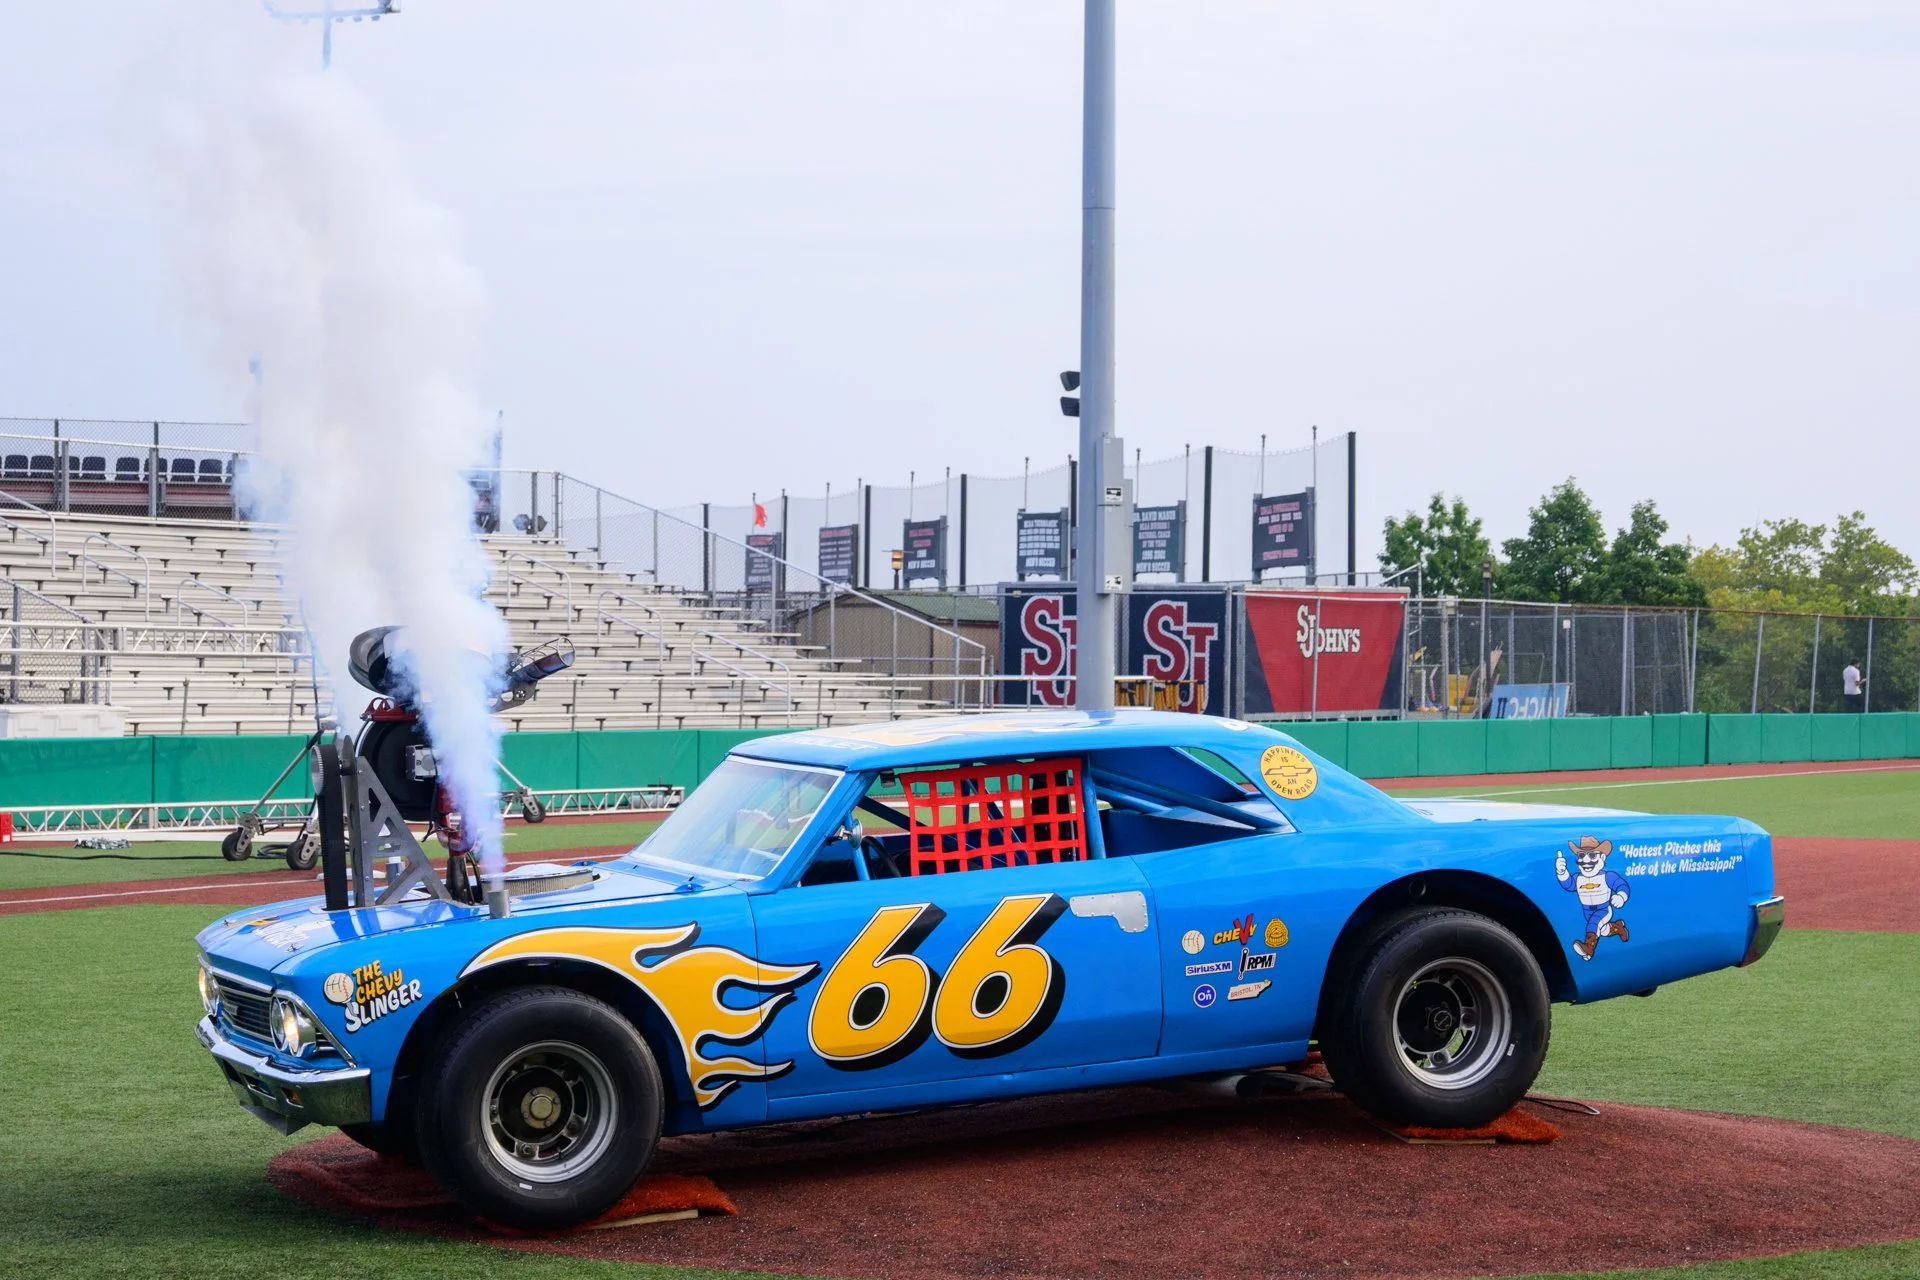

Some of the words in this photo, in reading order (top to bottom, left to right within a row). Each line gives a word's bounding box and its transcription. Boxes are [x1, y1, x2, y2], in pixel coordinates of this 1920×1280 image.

[1264, 747, 1306, 763] HAPPINESS
[1271, 779, 1293, 795] OPEN
[1296, 779, 1313, 795] ROAD
[1664, 841, 1701, 855] Pitches
[1703, 839, 1721, 853] this
[1625, 862, 1645, 876] side
[1648, 860, 1659, 877] of
[1661, 861, 1677, 874] the
[1213, 913, 1257, 945] CHEVY
[1187, 962, 1231, 975] SiriusXM
[1247, 955, 1273, 970] RPM
[352, 959, 383, 986] THE
[355, 968, 403, 1004] CHEVY
[1197, 990, 1212, 1001] On
[344, 978, 423, 1033] SLINGER
